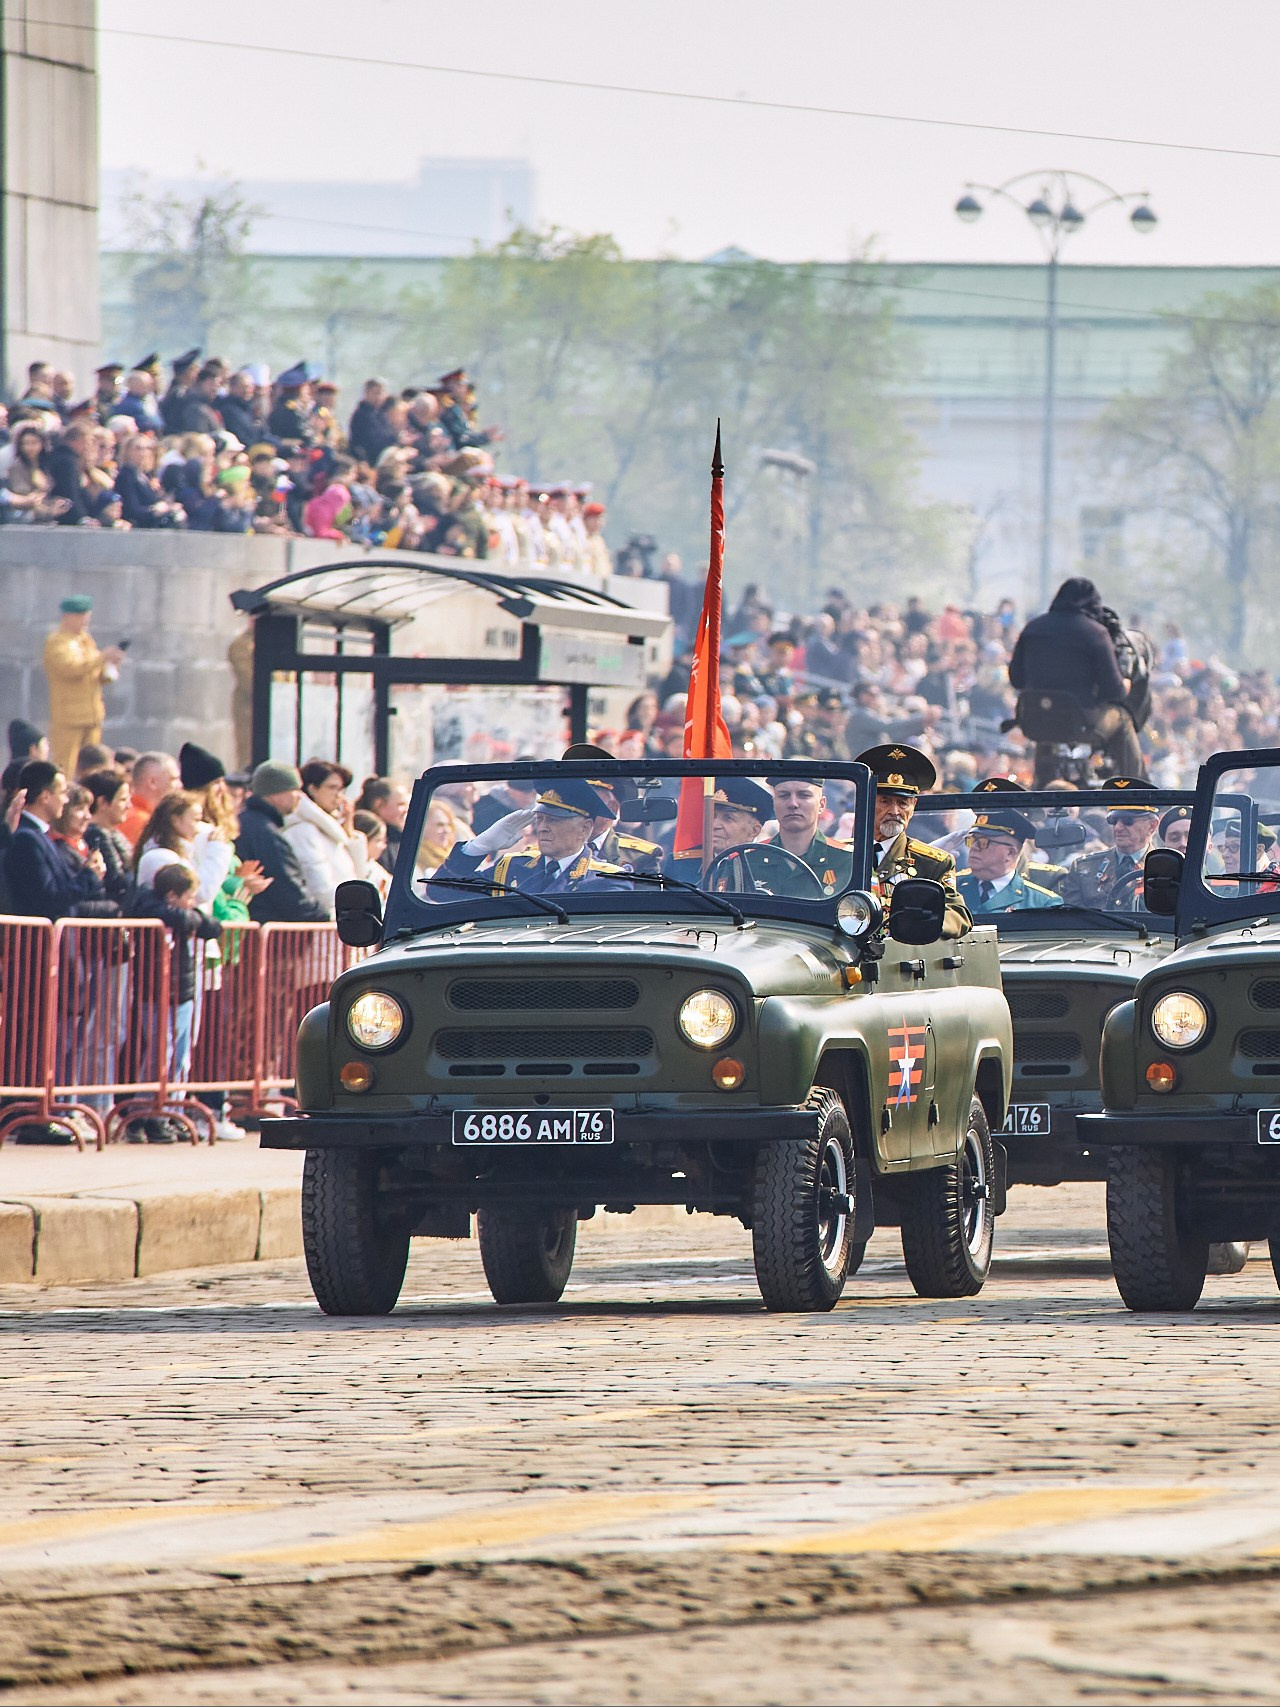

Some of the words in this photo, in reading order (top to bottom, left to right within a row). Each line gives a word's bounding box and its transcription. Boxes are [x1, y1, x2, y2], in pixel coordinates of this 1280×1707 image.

[577, 1111, 604, 1133] 76
[1018, 1106, 1042, 1125] 76
[463, 1113, 532, 1141] 6886
[580, 1132, 601, 1141] RUS
[1021, 1124, 1039, 1132] RUS
